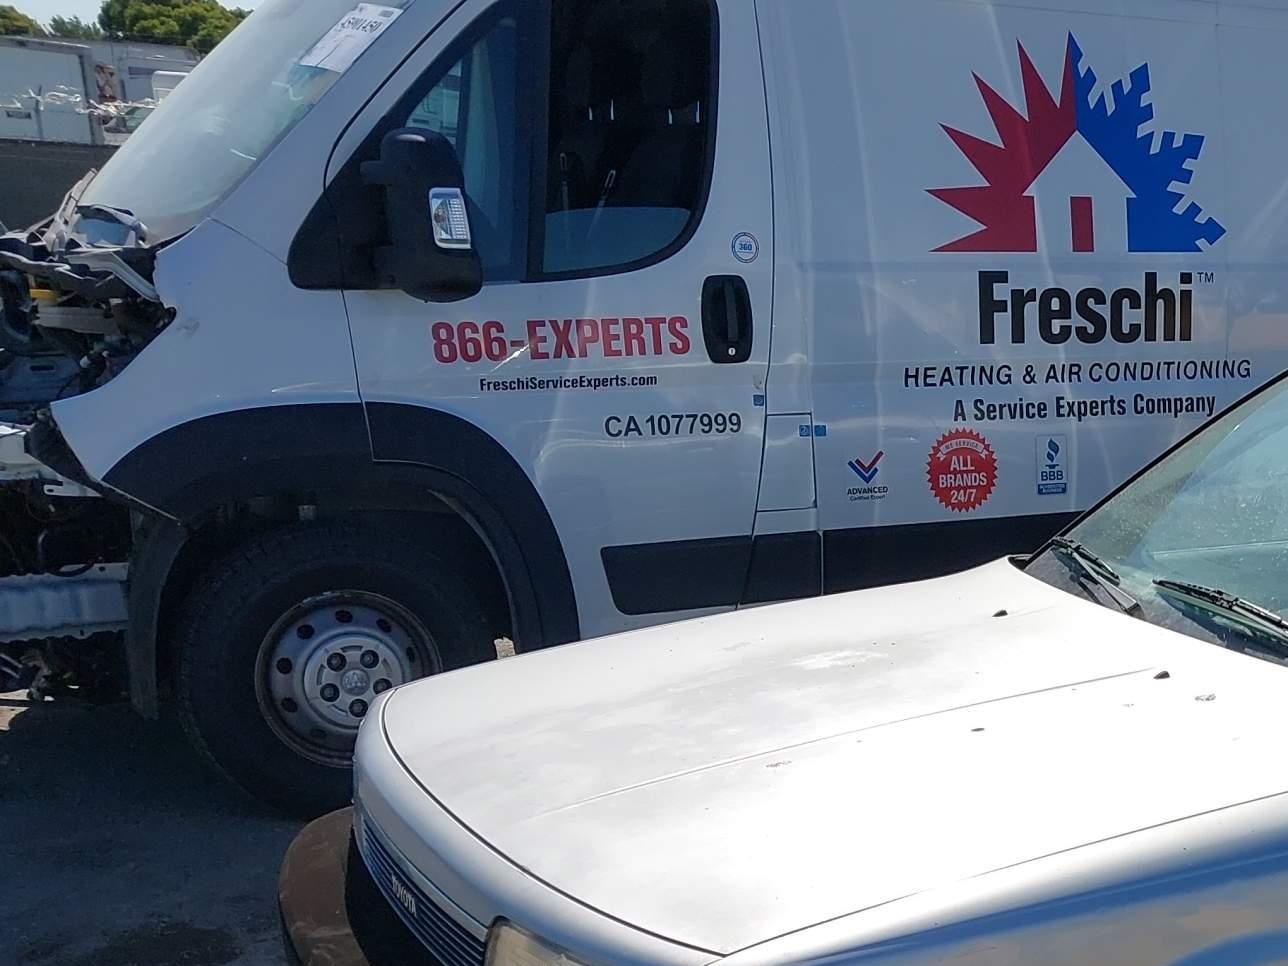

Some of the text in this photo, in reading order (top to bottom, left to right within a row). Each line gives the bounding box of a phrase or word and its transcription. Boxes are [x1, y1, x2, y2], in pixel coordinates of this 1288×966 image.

[977, 270, 1215, 345] Freschi TM
[431, 316, 691, 364] 866-EXPERTS
[903, 359, 1252, 388] HEATING & AIR CONDITIONING
[479, 374, 657, 392] FreschiServiceExperts.com
[953, 393, 1217, 422] A Service Experts Company
[949, 455, 976, 471] ALL
[938, 472, 988, 488] BRANDS
[1040, 470, 1064, 481] BBB
[847, 486, 889, 495] ADVANCED
[950, 488, 977, 503] 24/7
[391, 874, 418, 918] TOYOTA
